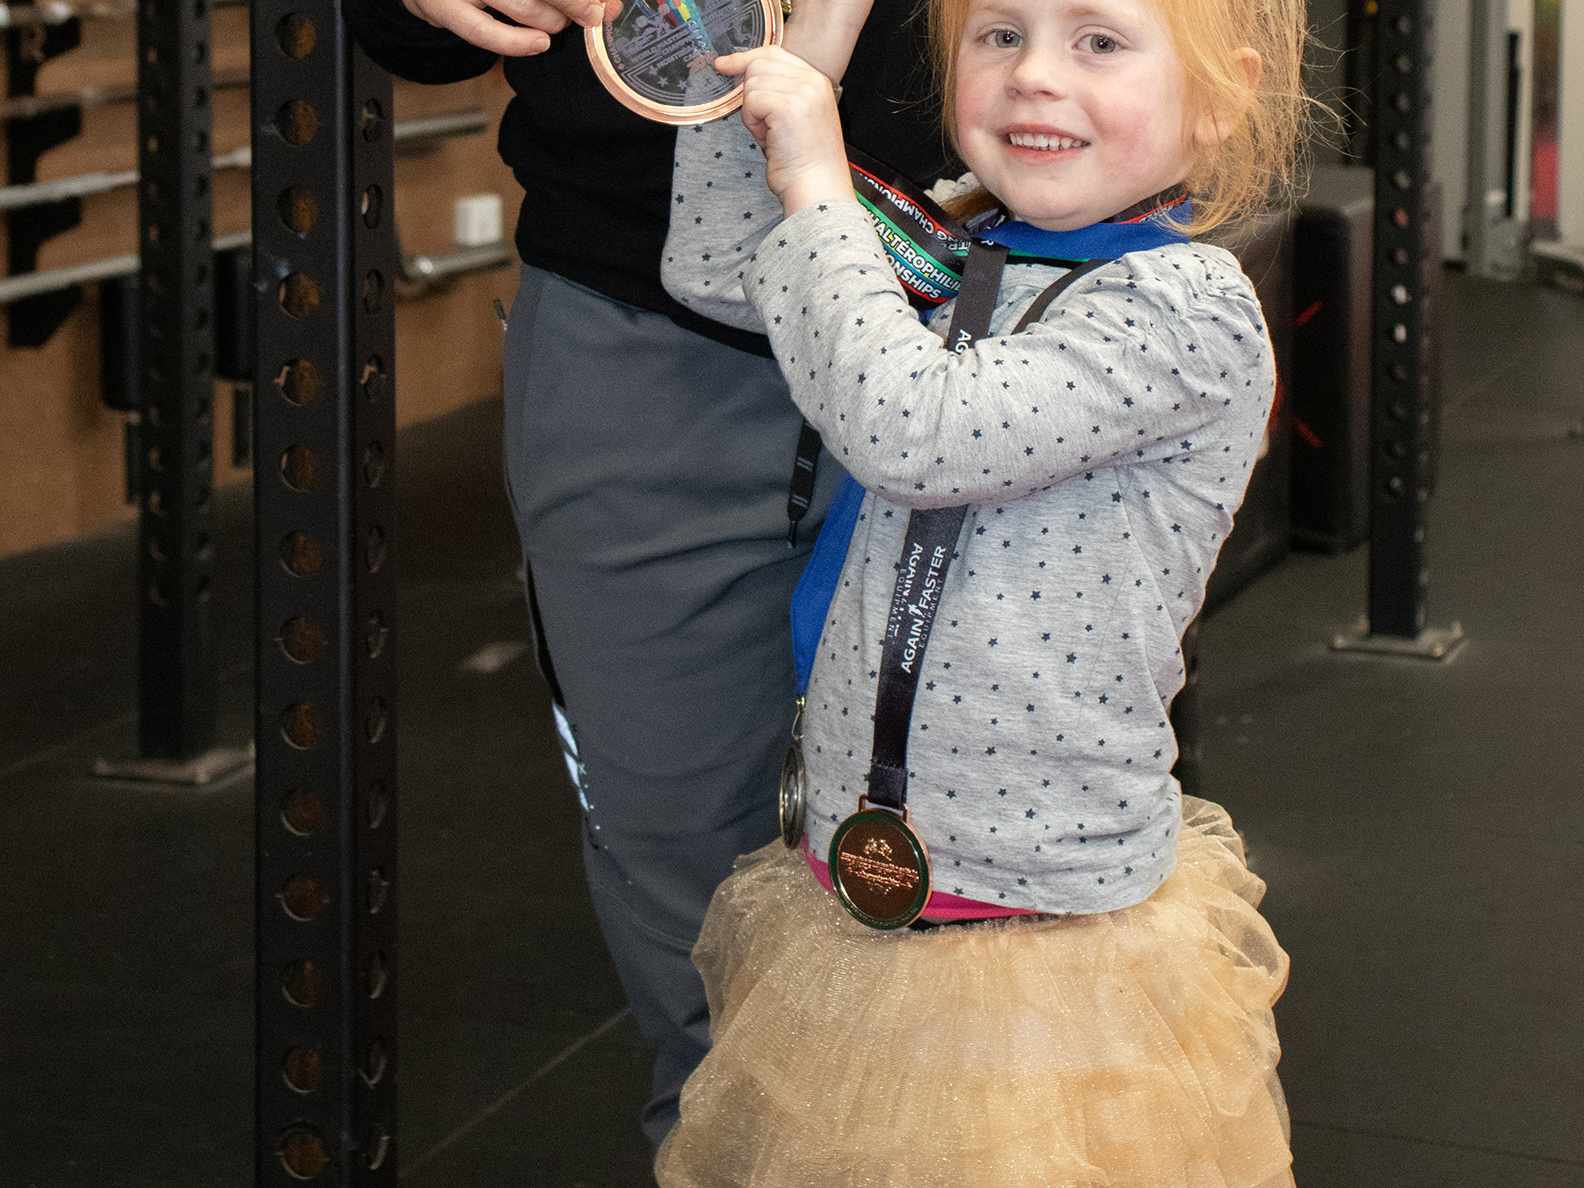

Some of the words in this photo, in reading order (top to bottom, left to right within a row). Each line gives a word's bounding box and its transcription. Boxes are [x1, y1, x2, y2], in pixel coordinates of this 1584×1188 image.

[886, 568, 908, 642] EQUIPMENT
[901, 616, 925, 674] AGAIN
[918, 545, 947, 610] FASTER
